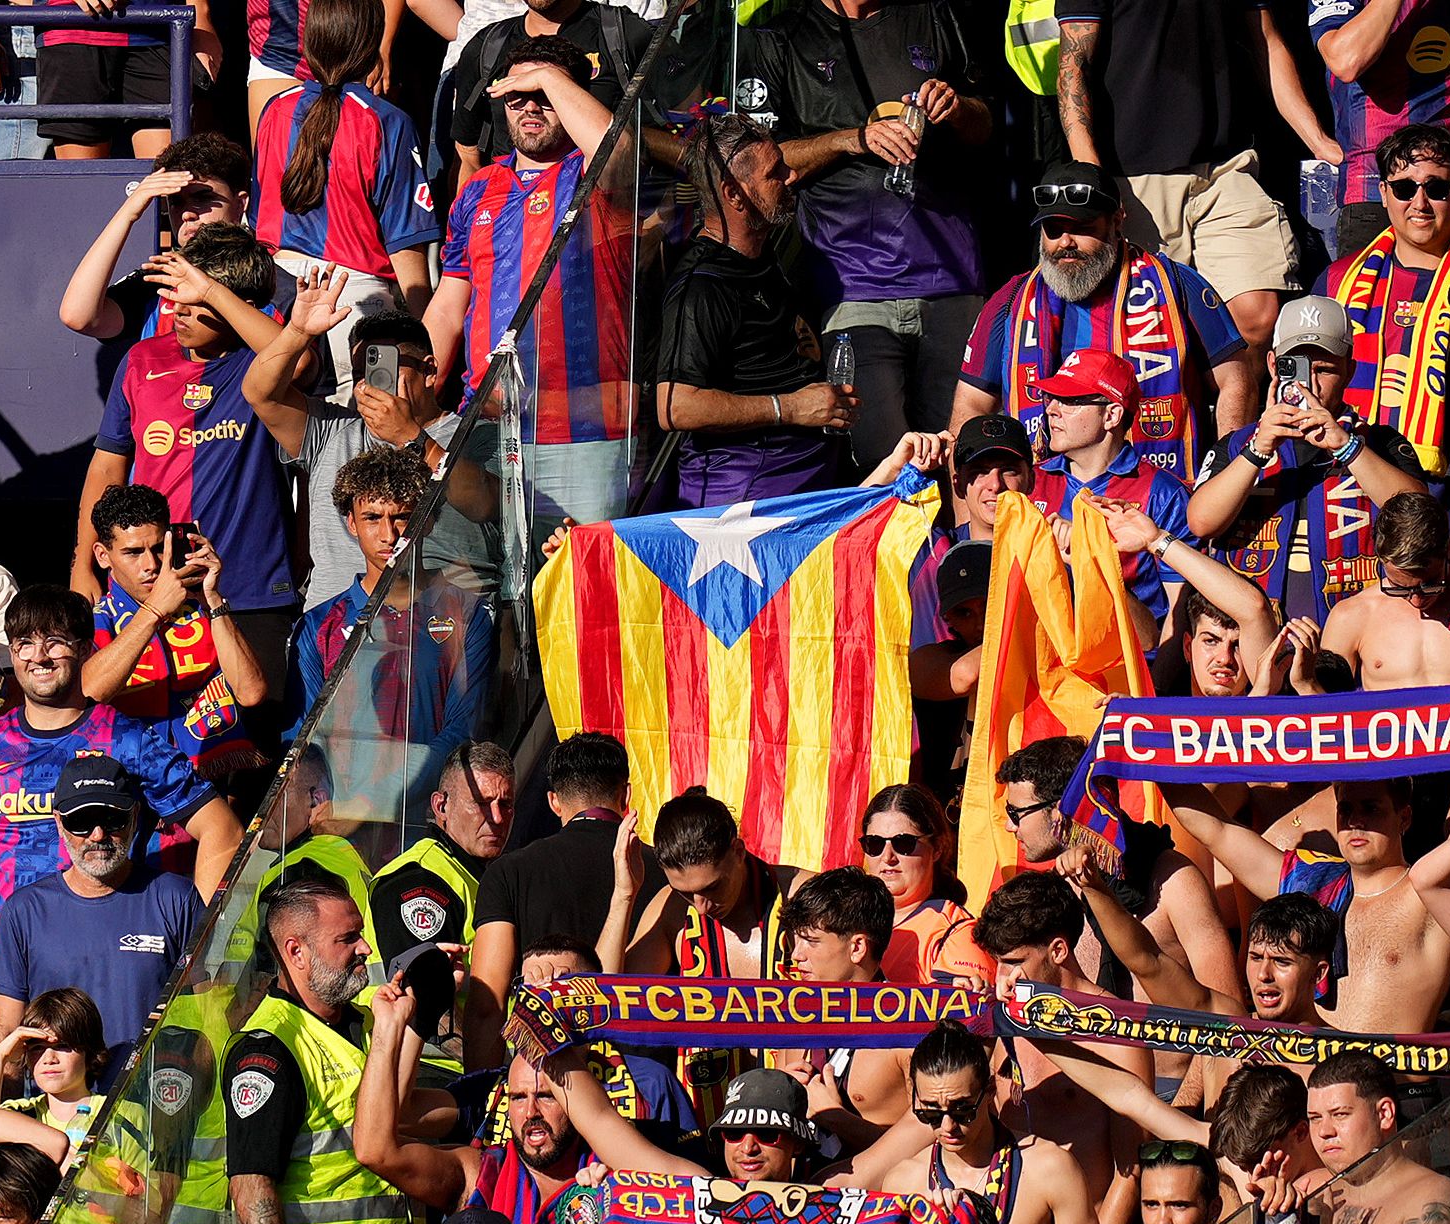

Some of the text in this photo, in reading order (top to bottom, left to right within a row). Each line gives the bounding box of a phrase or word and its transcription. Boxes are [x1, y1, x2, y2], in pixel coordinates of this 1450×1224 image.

[178, 419, 247, 446] Spotify
[1096, 711, 1156, 764] FC
[561, 993, 596, 1008] FCB
[517, 990, 567, 1044] 1899
[722, 1108, 793, 1128] ADIDAS
